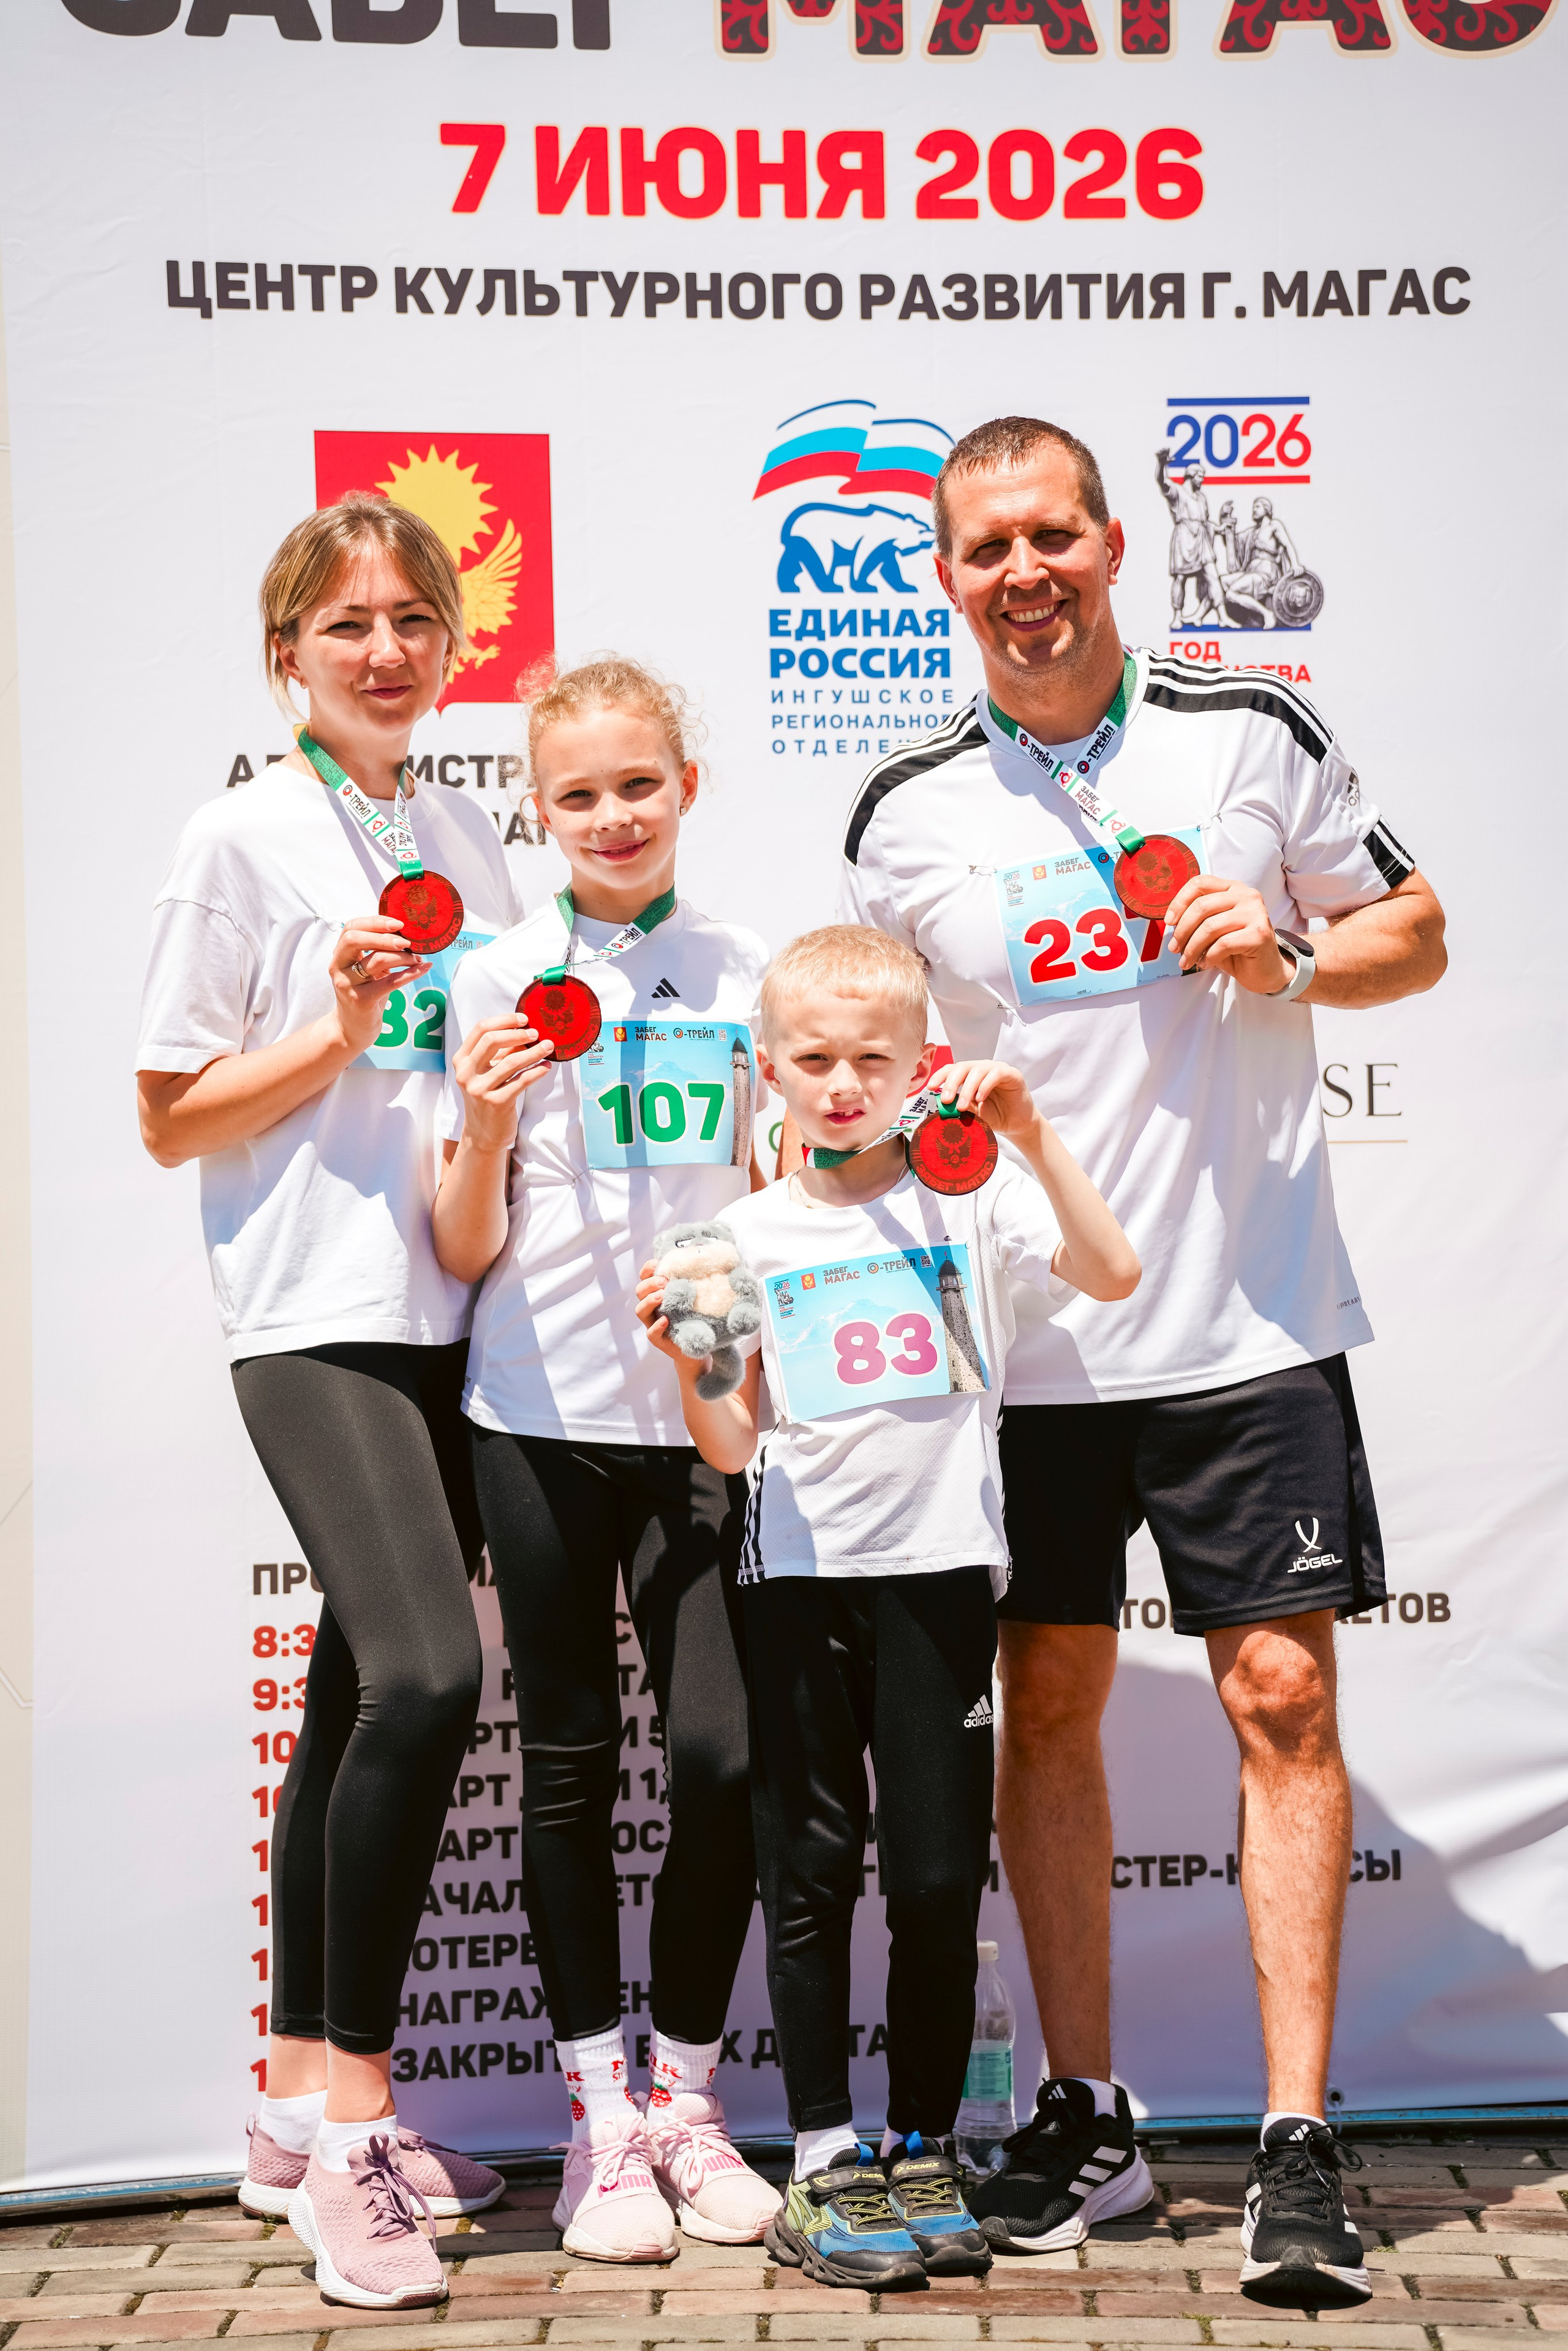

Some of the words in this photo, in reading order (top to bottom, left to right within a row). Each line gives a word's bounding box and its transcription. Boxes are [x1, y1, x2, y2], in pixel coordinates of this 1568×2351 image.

[440, 123, 507, 214] 7
[535, 126, 886, 221] ИЮНЯ
[915, 128, 1205, 222] 2026
[167, 260, 379, 320] ЦЕНТР
[395, 267, 843, 321] КУЛЬТУРНОГО
[861, 273, 1186, 322] РАЗВИТИЯ
[1203, 272, 1247, 319] Г.
[1264, 267, 1472, 319] МАГАС
[1167, 413, 1313, 469] 2026
[769, 609, 951, 641] ЕДИНАЯ
[770, 648, 951, 679] РОССИЯ
[1169, 641, 1222, 663] ГОД
[772, 689, 953, 704] ИНГУШСКОЕ
[1055, 861, 1091, 876] МАГАС
[635, 1033, 668, 1041] МАГАС
[597, 1083, 726, 1145] 107
[956, 1161, 994, 1192] МАГАС
[823, 1266, 848, 1277] ЗАБЕГ
[824, 1270, 861, 1285] МАГАС
[834, 1313, 938, 1384] 83
[1287, 1553, 1343, 1574] JÖGEL
[963, 1713, 993, 1728] adidas
